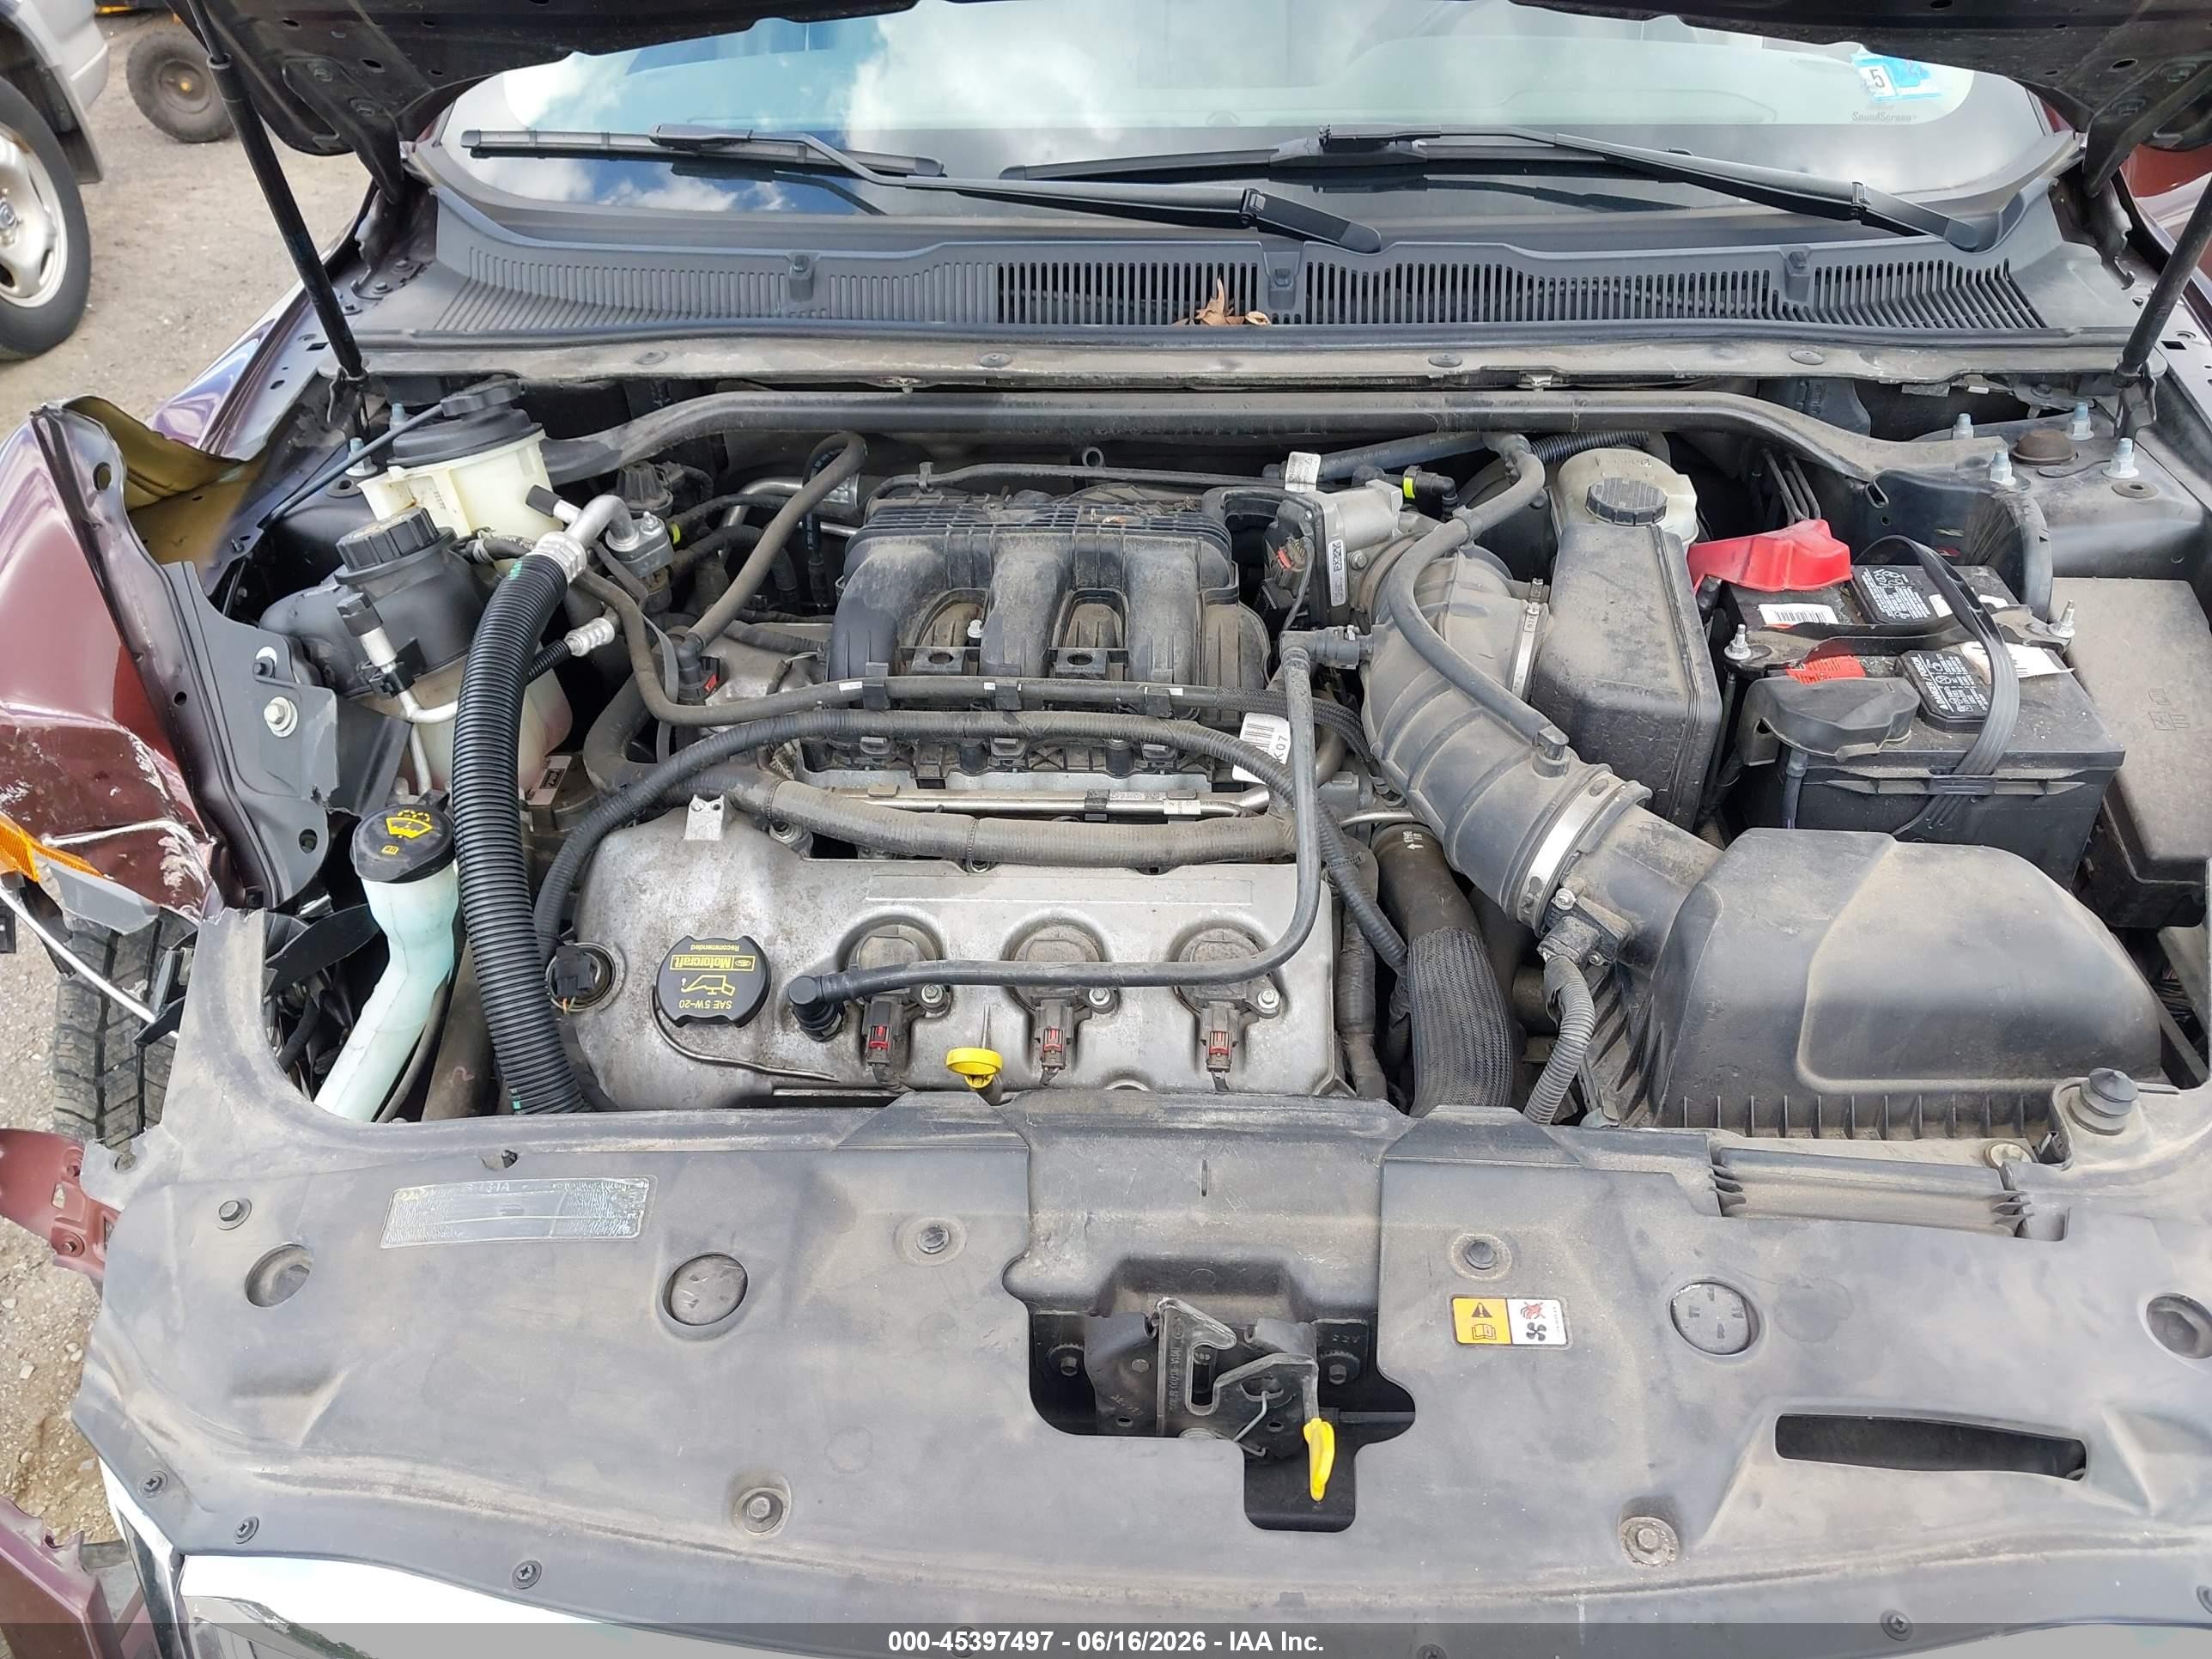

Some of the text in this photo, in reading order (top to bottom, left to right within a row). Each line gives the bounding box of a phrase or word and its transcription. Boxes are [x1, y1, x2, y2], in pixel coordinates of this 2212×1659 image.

[1869, 69, 1886, 88] 5
[1911, 656, 1928, 678] POISON
[1925, 681, 1945, 706] DANGER
[674, 956, 732, 969] Motorcraft
[679, 999, 732, 1010] SAE 5W-20
